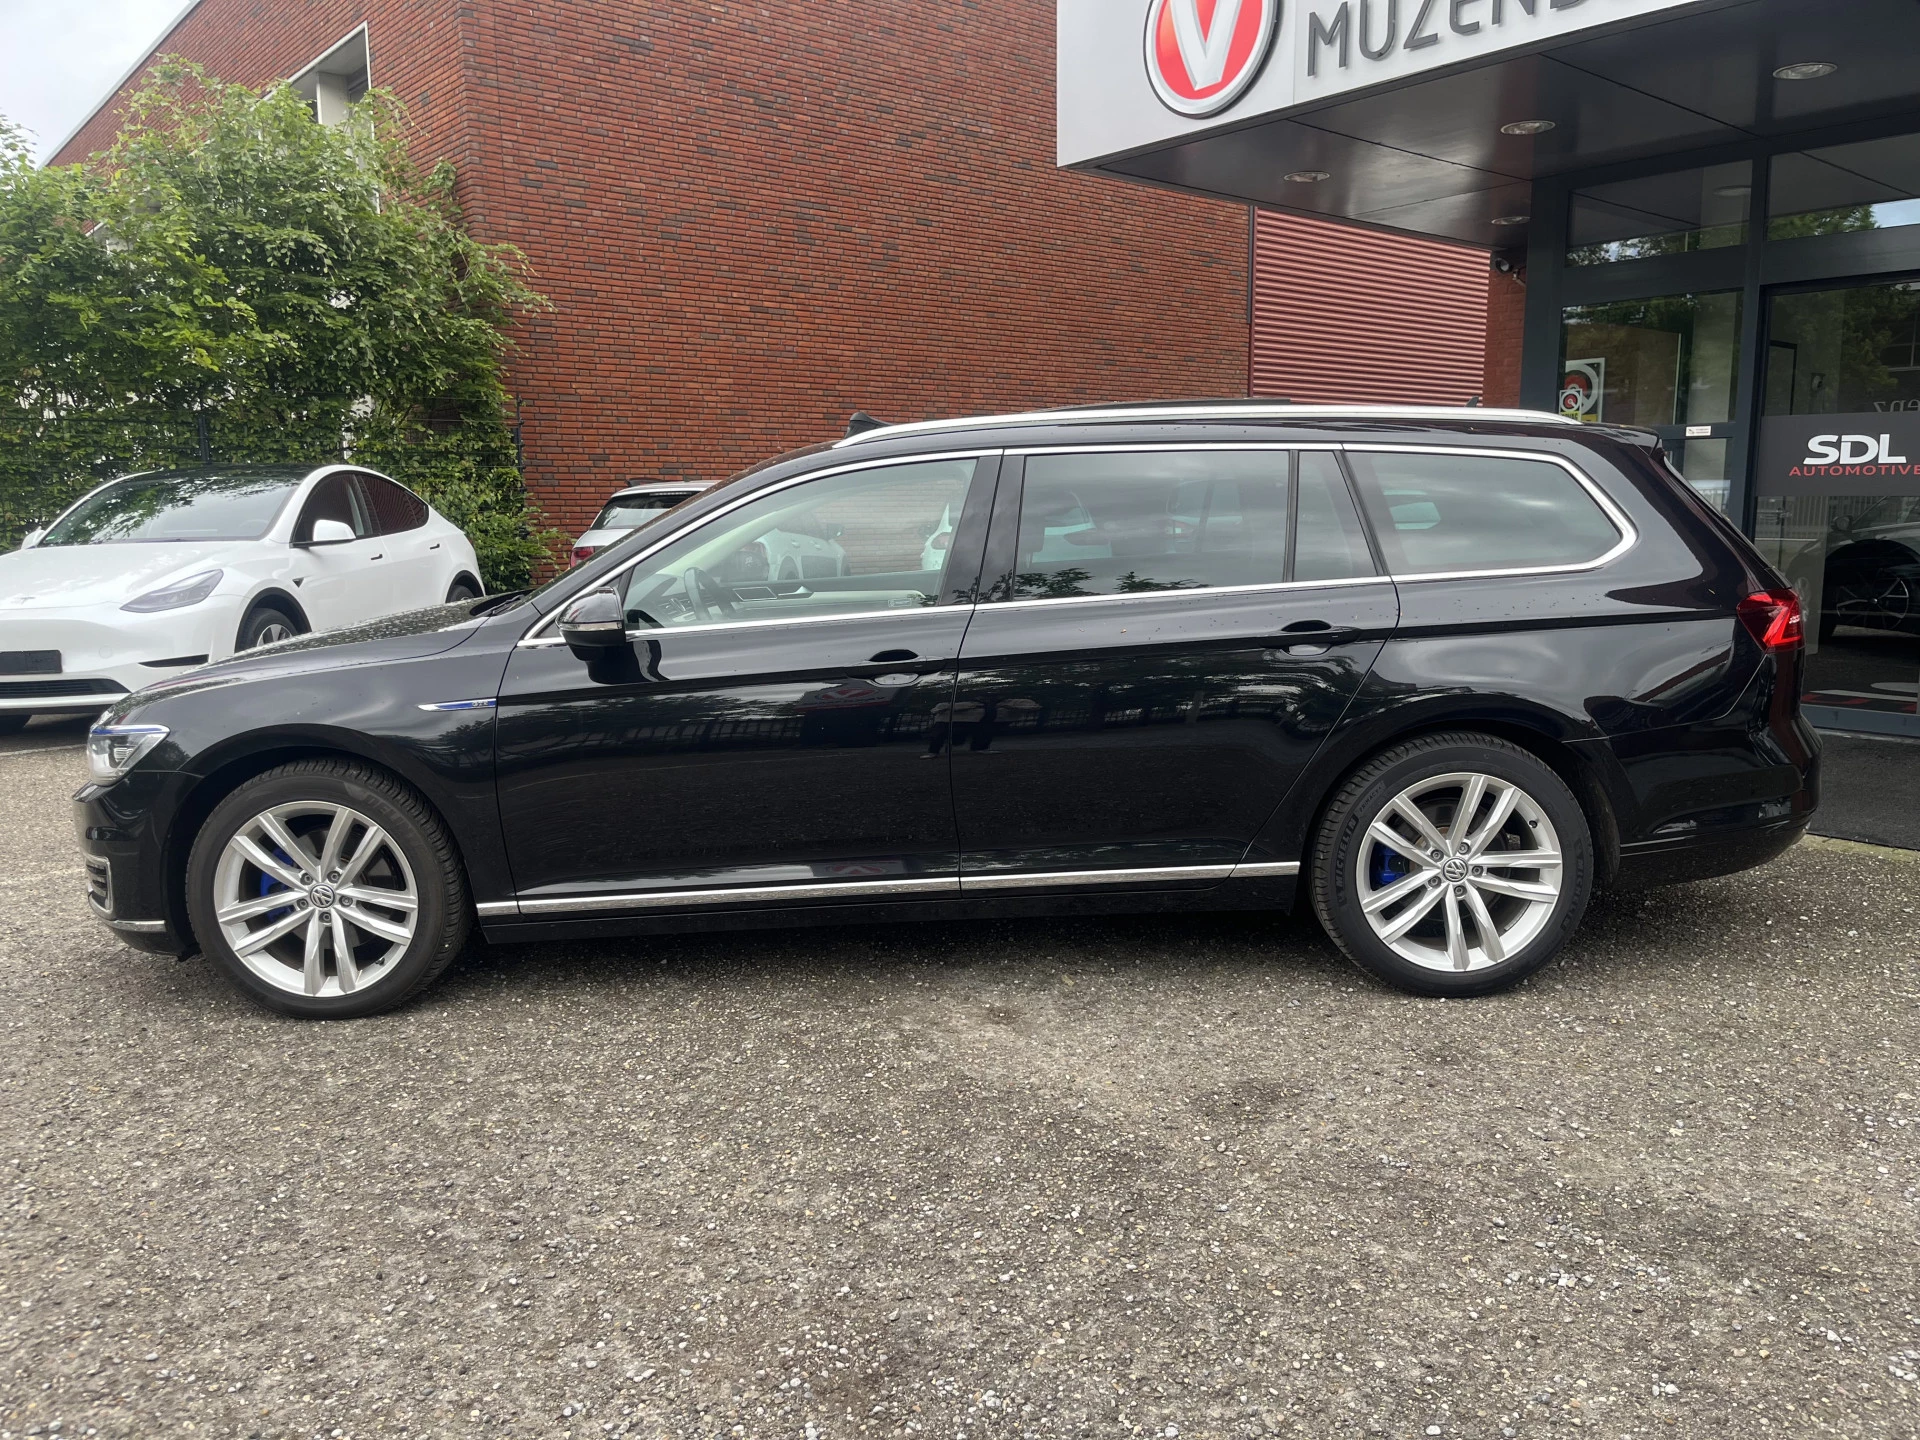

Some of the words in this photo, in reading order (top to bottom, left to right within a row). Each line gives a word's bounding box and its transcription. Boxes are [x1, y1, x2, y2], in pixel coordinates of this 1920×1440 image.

[1307, 0, 1584, 77] MUZE
[1788, 464, 1920, 477] AUTOMOTIVE
[1803, 433, 1907, 465] SDL
[1335, 815, 1358, 888] MICHELIN
